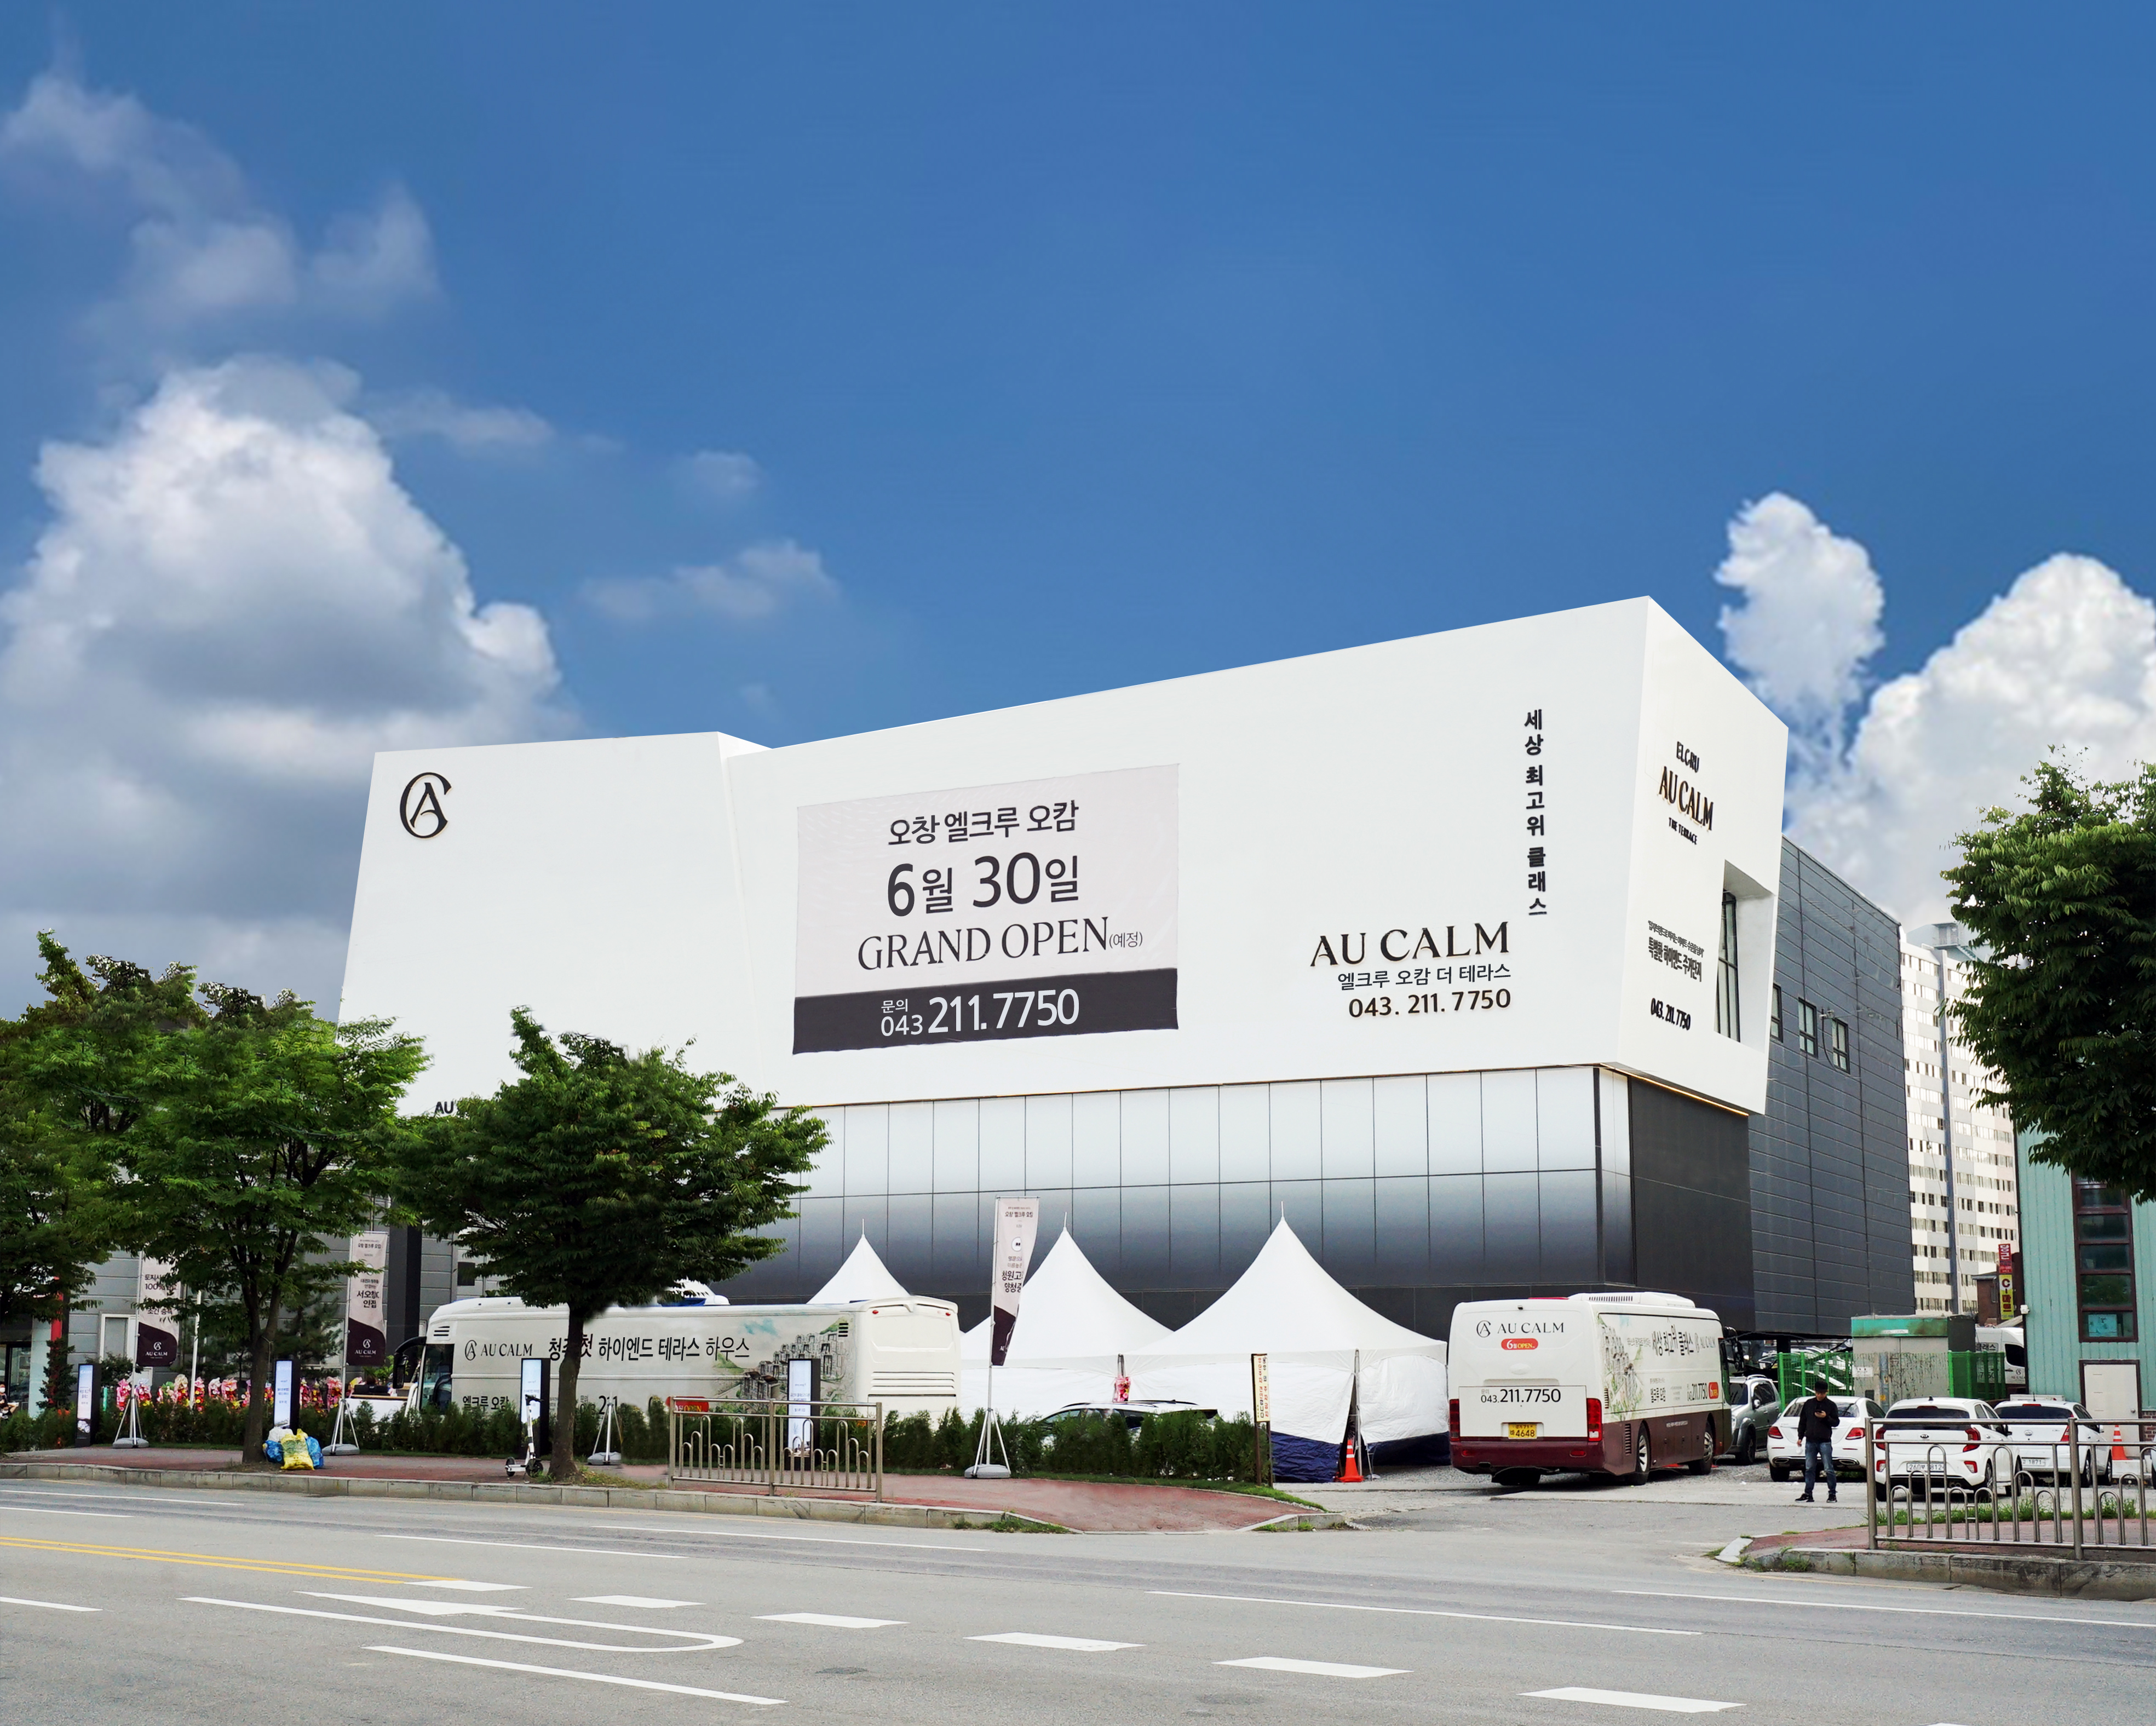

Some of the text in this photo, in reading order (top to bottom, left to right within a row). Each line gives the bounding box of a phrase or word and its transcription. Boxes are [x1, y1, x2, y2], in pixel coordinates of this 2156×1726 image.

[1676, 741, 1699, 773] ELCRU
[1524, 709, 1547, 915] 세상 최고위 클래스
[1659, 766, 1714, 831] AU CALM
[888, 799, 1079, 845] 오창 엘크루 오캄
[888, 852, 1079, 917] 6월 30일
[858, 928, 991, 970] GRAND
[1310, 921, 1509, 967] AU CALM
[1648, 936, 1702, 982] 특별한 하이엔드 주거단지
[1338, 964, 1511, 991] 엘크루 오캄 더 테라스
[881, 998, 908, 1013] 문의
[881, 988, 1079, 1037] 043 211.7750
[481, 1343, 497, 1356] AU
[499, 1343, 533, 1357] CALM
[599, 1337, 653, 1361] 하이엔드
[658, 1337, 700, 1361] 테라스
[705, 1336, 750, 1361] 하우스
[1497, 1323, 1517, 1334] AU
[1521, 1322, 1565, 1334] CALM
